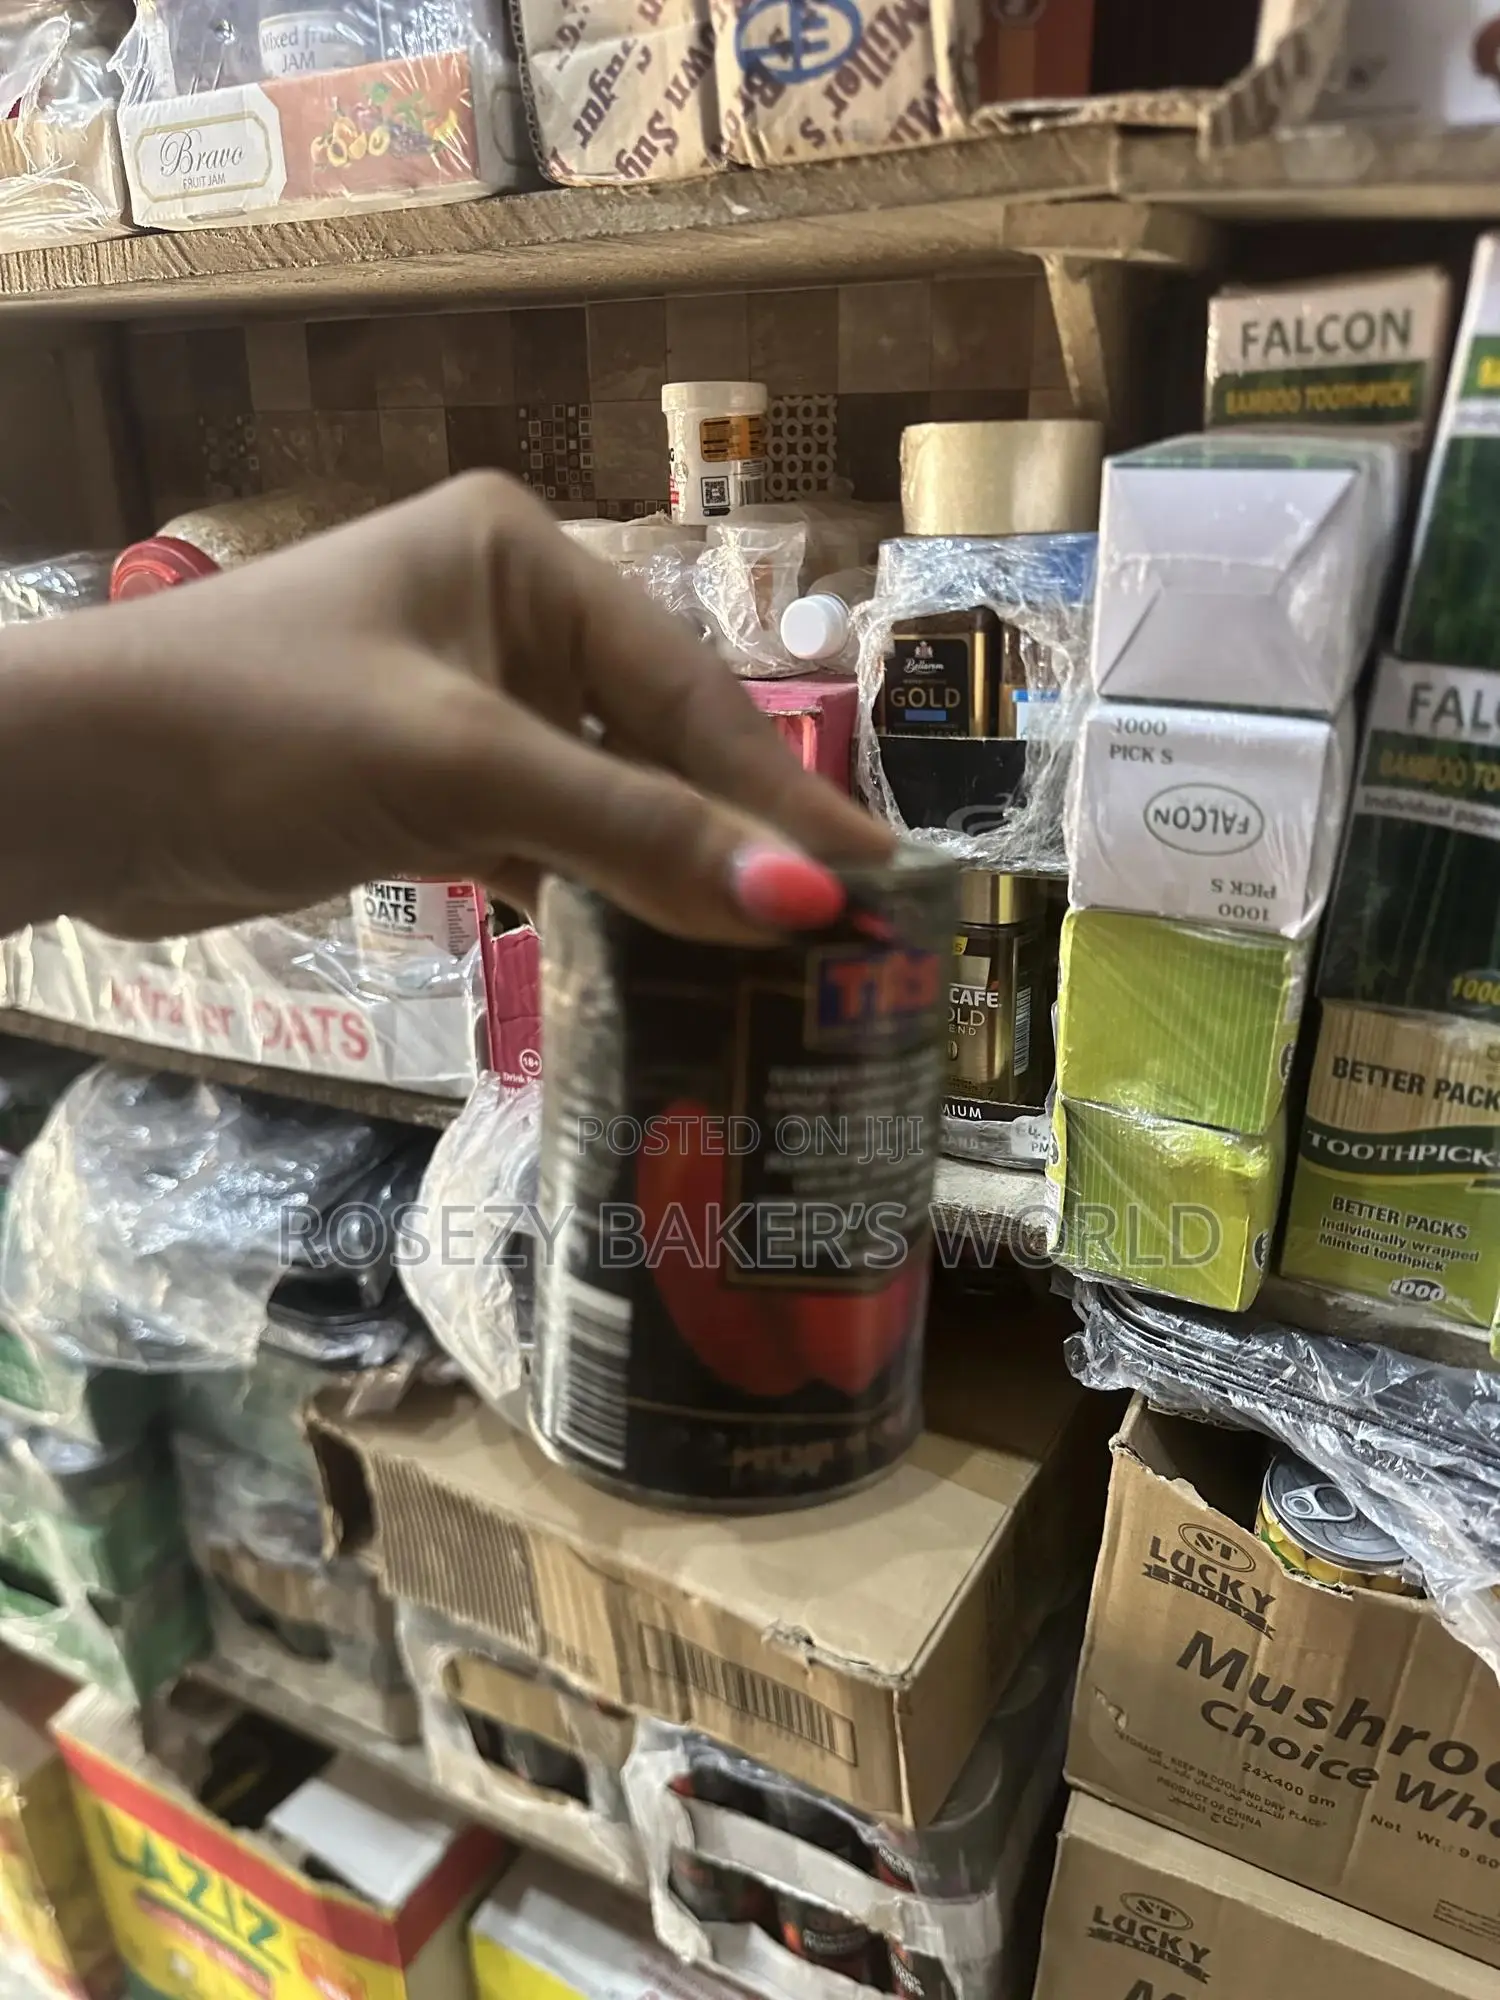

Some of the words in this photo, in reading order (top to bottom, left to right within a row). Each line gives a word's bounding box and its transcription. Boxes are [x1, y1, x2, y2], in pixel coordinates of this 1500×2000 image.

[282, 50, 316, 73] JAM
[160, 128, 243, 177] Bravo
[182, 174, 206, 189] FRUIT
[207, 173, 226, 187] JAM
[1240, 308, 1413, 358] FALCON
[890, 687, 961, 708] GOLD
[1407, 680, 1500, 732] FAL
[1116, 717, 1167, 737] 1000
[1109, 743, 1156, 763] PICK
[1154, 806, 1249, 836] FALCON
[364, 881, 417, 903] WHITE
[1230, 882, 1277, 900] PICK
[364, 896, 418, 925] OATS
[1218, 903, 1270, 923] 1000
[251, 999, 370, 1061] OATS
[943, 1007, 985, 1027] OLD
[948, 1023, 977, 1036] END
[1332, 1056, 1426, 1097] BETTER
[941, 1103, 982, 1119] MIUM
[1331, 1195, 1401, 1226] BETTER
[1405, 1213, 1469, 1241] PACKS
[1318, 1233, 1370, 1256] Minted
[1372, 1246, 1445, 1273] toothpick
[1321, 1216, 1408, 1250] Individually
[1411, 1240, 1480, 1263] wrapped
[1390, 1279, 1445, 1301] 1000
[1194, 1532, 1238, 1561] ST
[1149, 1535, 1277, 1616] LUCKY
[1167, 1572, 1250, 1618] FAMILY
[1200, 1699, 1381, 1789] Choice
[1239, 1788, 1262, 1801] AND
[1241, 1762, 1304, 1796] 24X400
[1307, 1794, 1336, 1809] gm
[1156, 1775, 1208, 1803] PRODUCT
[1226, 1806, 1262, 1828] CHINA
[1370, 1814, 1402, 1834] Net
[1136, 1899, 1177, 1922] ST
[1092, 1905, 1211, 1963] LUCKY
